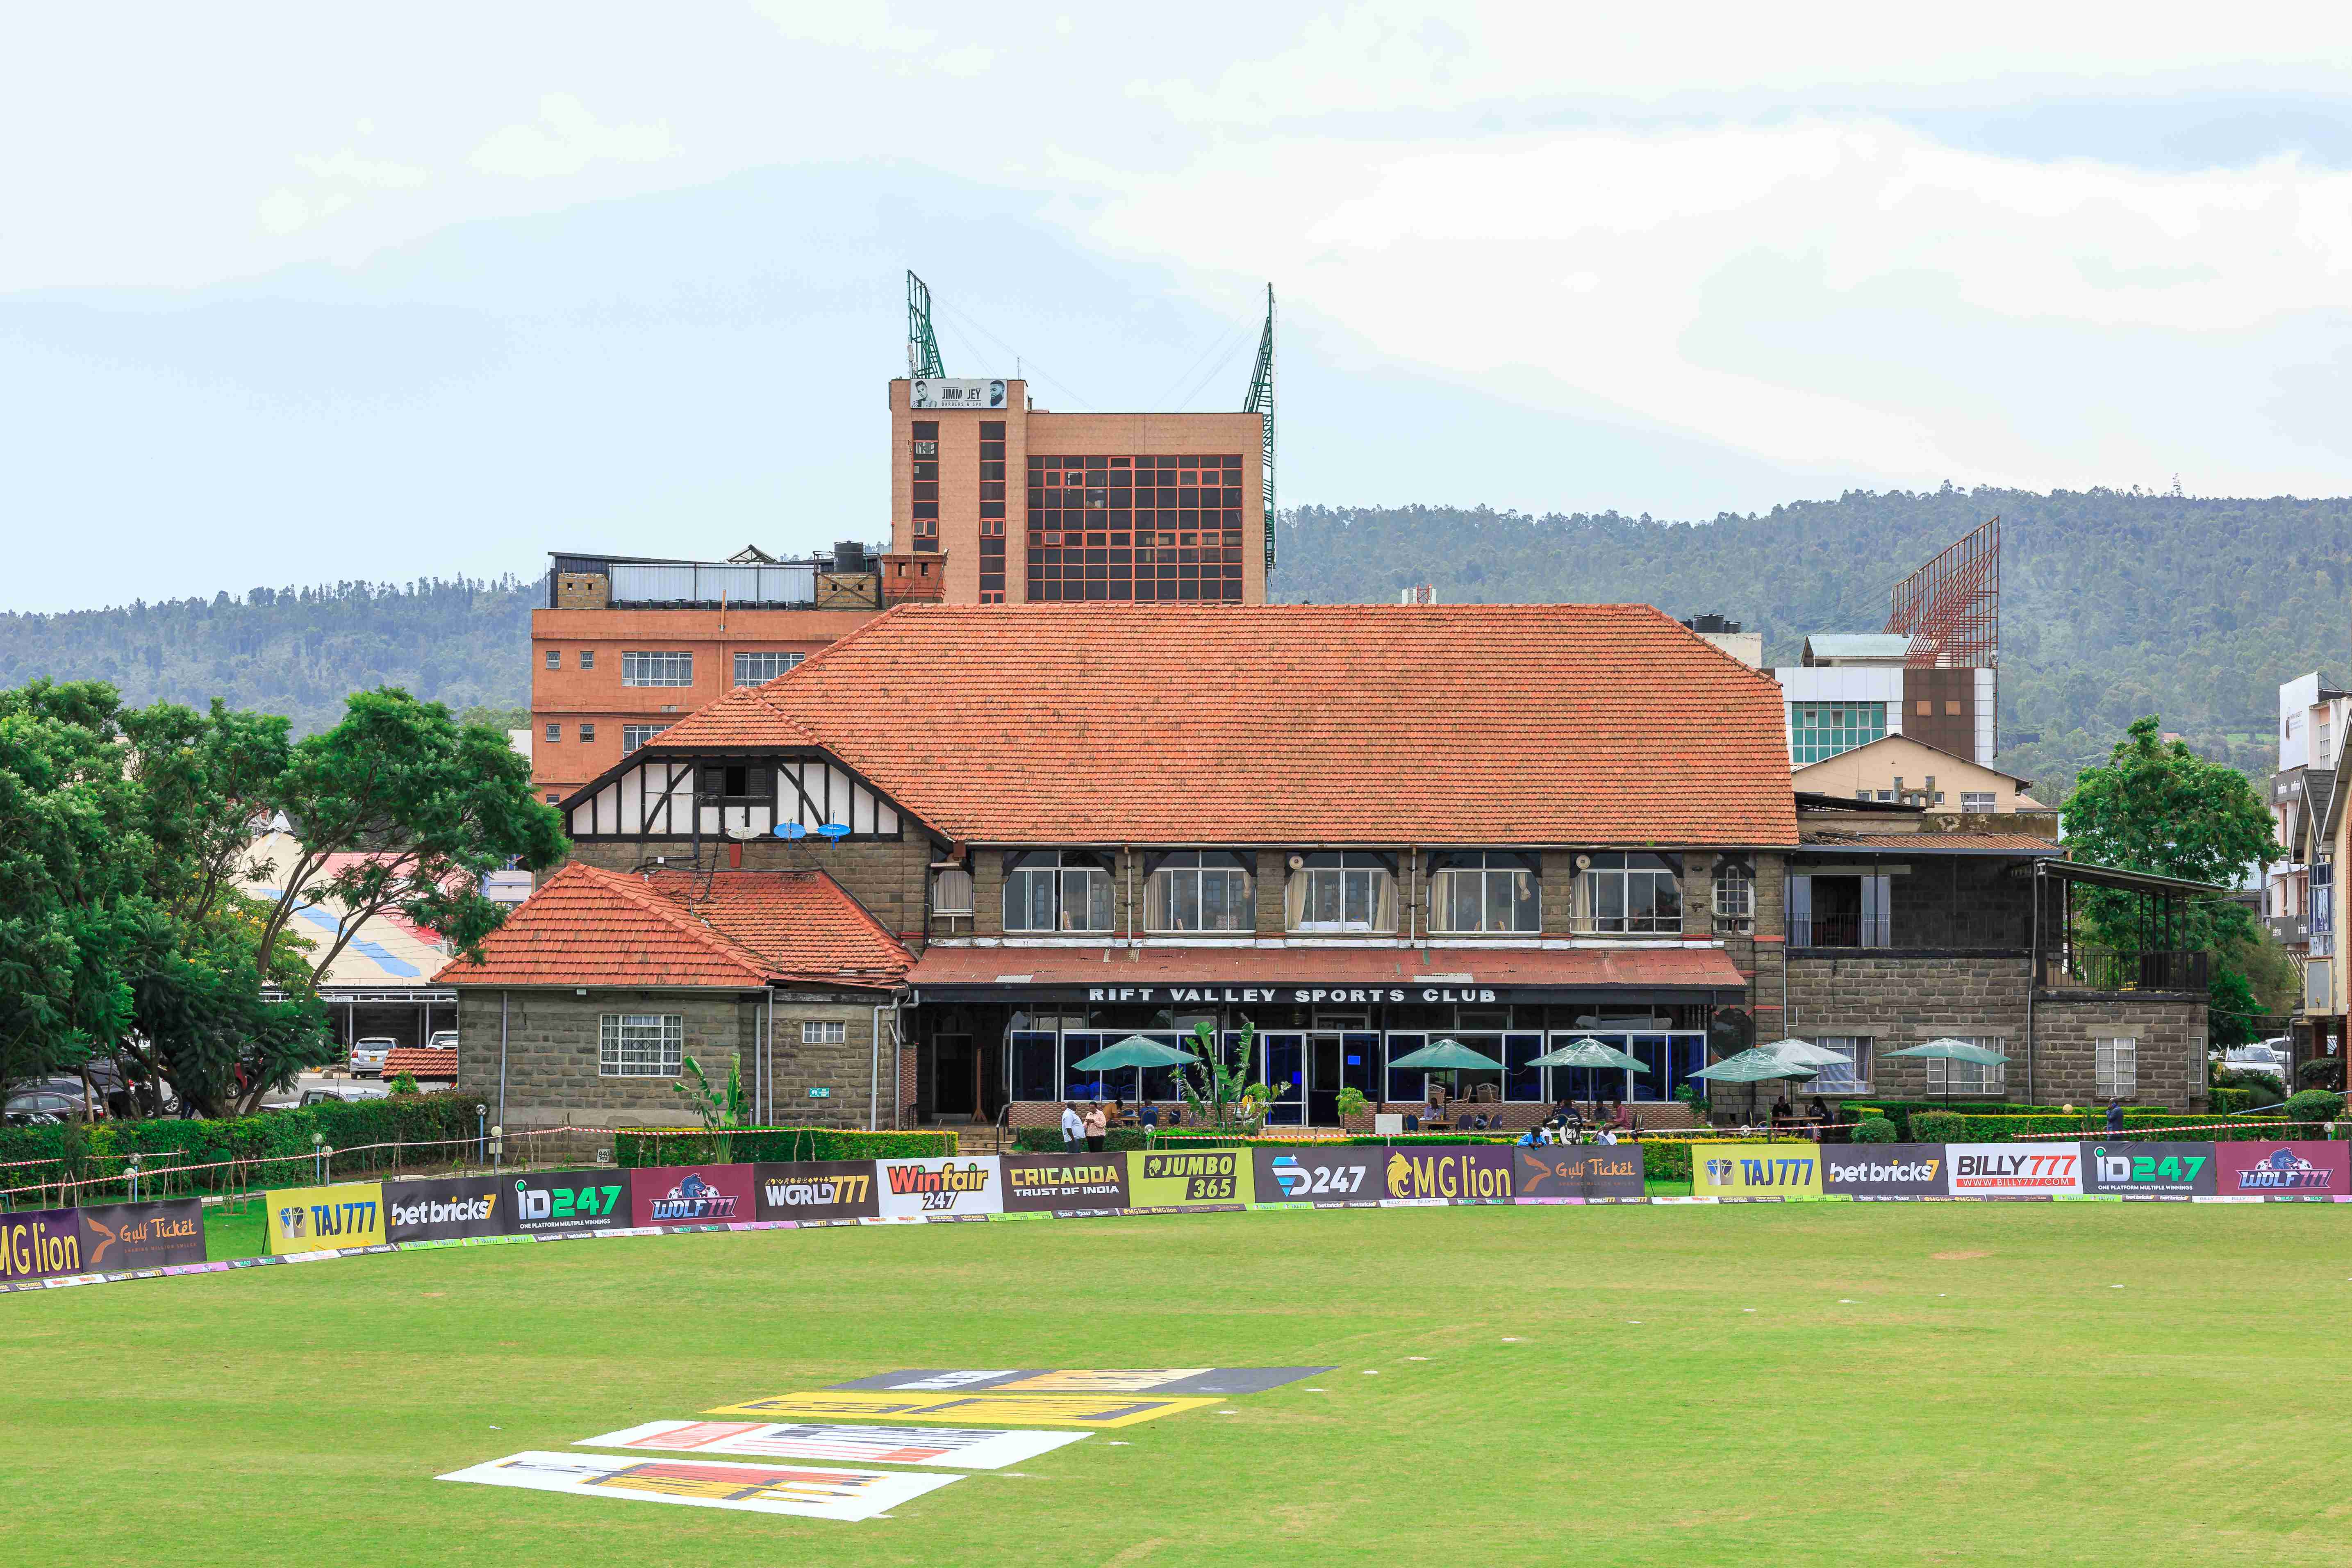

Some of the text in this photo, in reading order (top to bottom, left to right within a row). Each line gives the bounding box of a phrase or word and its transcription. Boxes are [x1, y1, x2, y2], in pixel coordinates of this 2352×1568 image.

[967, 389, 981, 399] JEY
[1089, 988, 1495, 1002] RIFT VALLEY SPORTS CLUB
[1162, 1155, 1233, 1176] JUMBO
[887, 1163, 989, 1195] Winfair
[1010, 1166, 1120, 1186] CRICADDA
[1963, 1178, 2069, 1186] WWW.BILLY777.COM
[1013, 1186, 1119, 1197] TRUST OF INDIA
[1193, 1179, 1231, 1198] 365
[922, 1191, 958, 1211] 247
